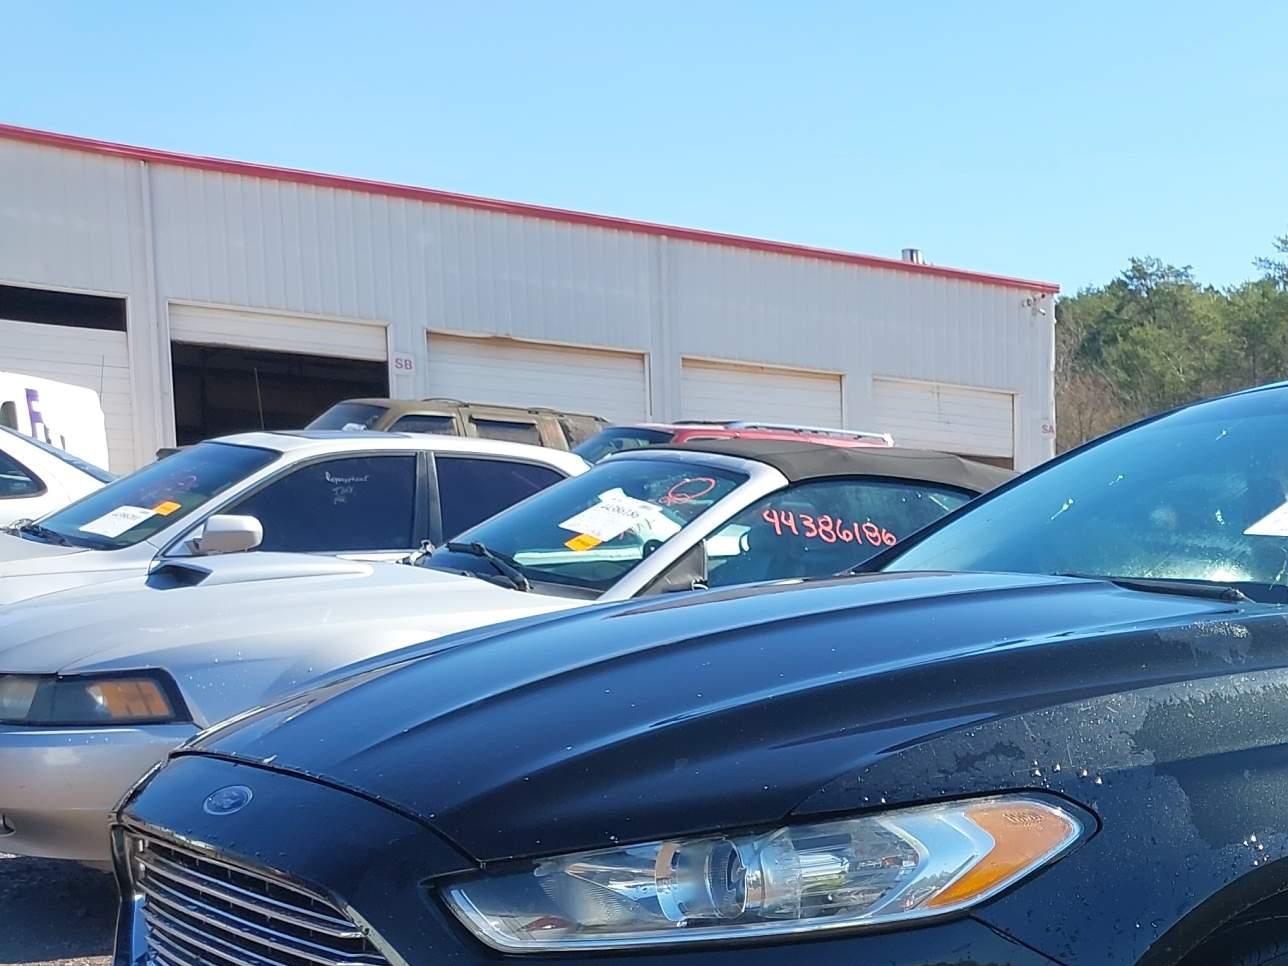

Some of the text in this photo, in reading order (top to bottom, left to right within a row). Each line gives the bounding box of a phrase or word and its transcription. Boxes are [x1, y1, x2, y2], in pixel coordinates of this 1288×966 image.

[394, 358, 413, 370] SB
[1041, 424, 1055, 434] SA
[762, 509, 897, 547] 44386186
